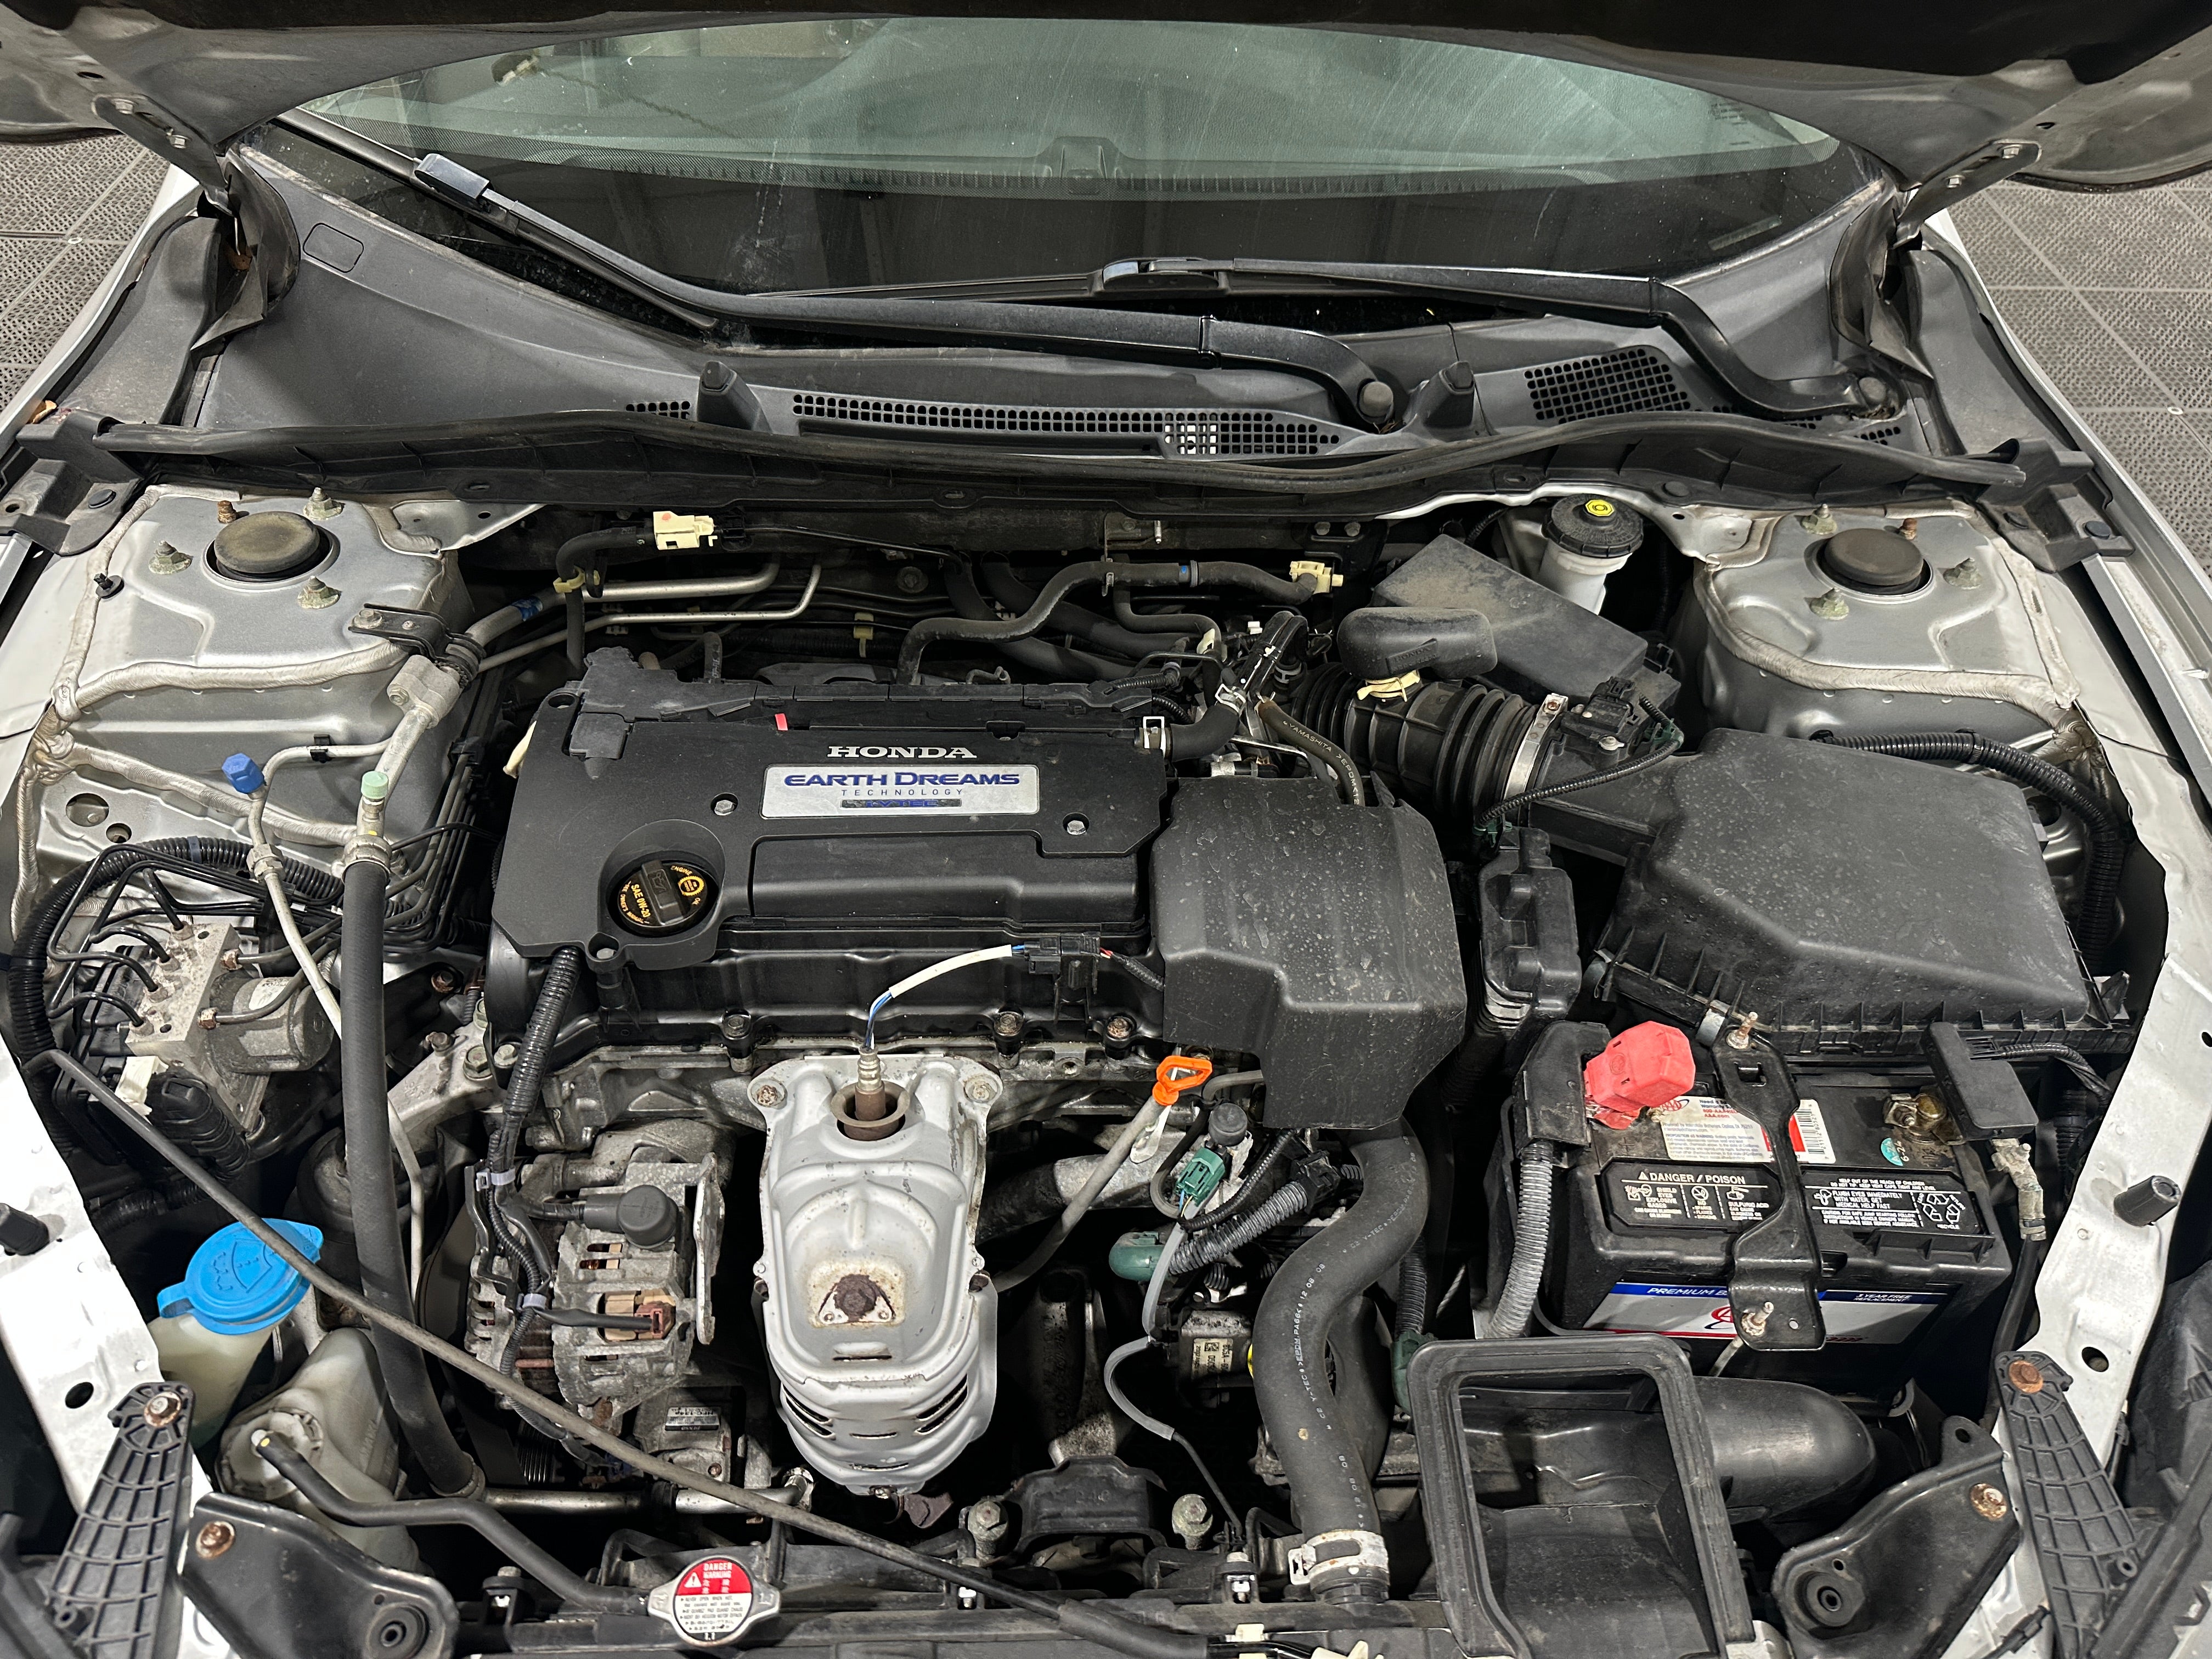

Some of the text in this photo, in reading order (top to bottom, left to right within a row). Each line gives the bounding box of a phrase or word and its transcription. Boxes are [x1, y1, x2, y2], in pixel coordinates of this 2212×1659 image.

[1289, 723, 1332, 752] YAMASHITA
[827, 746, 977, 759] HONDA
[785, 772, 1020, 786] EARTH DREAMS
[670, 865, 693, 876] ENGINE
[631, 884, 643, 899] SAE
[1650, 1172, 1695, 1183] DANGER
[1706, 1175, 1746, 1184] POISON
[703, 1562, 732, 1571] DANGER
